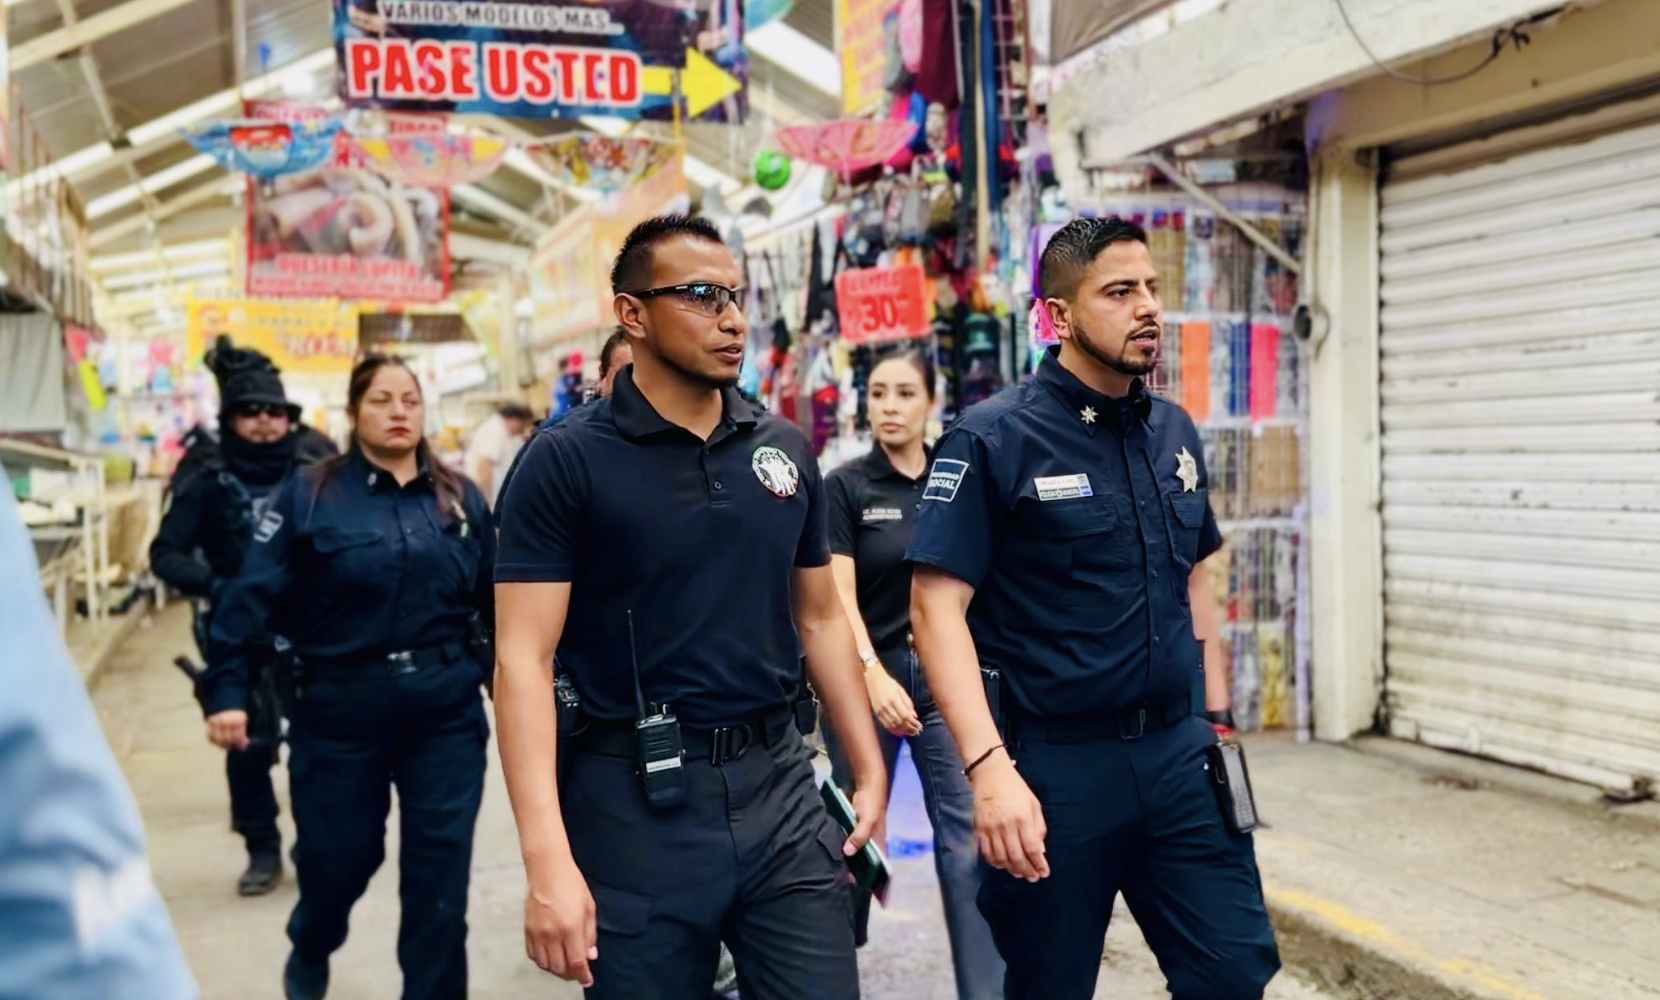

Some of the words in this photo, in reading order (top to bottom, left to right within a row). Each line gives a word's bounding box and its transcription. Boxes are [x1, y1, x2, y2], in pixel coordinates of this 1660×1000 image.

[380, 3, 459, 22] VARIOS
[465, 6, 559, 28] MODELOS
[350, 42, 475, 97] PASE
[487, 47, 639, 105] USTED
[928, 478, 956, 490] SOCIAL
